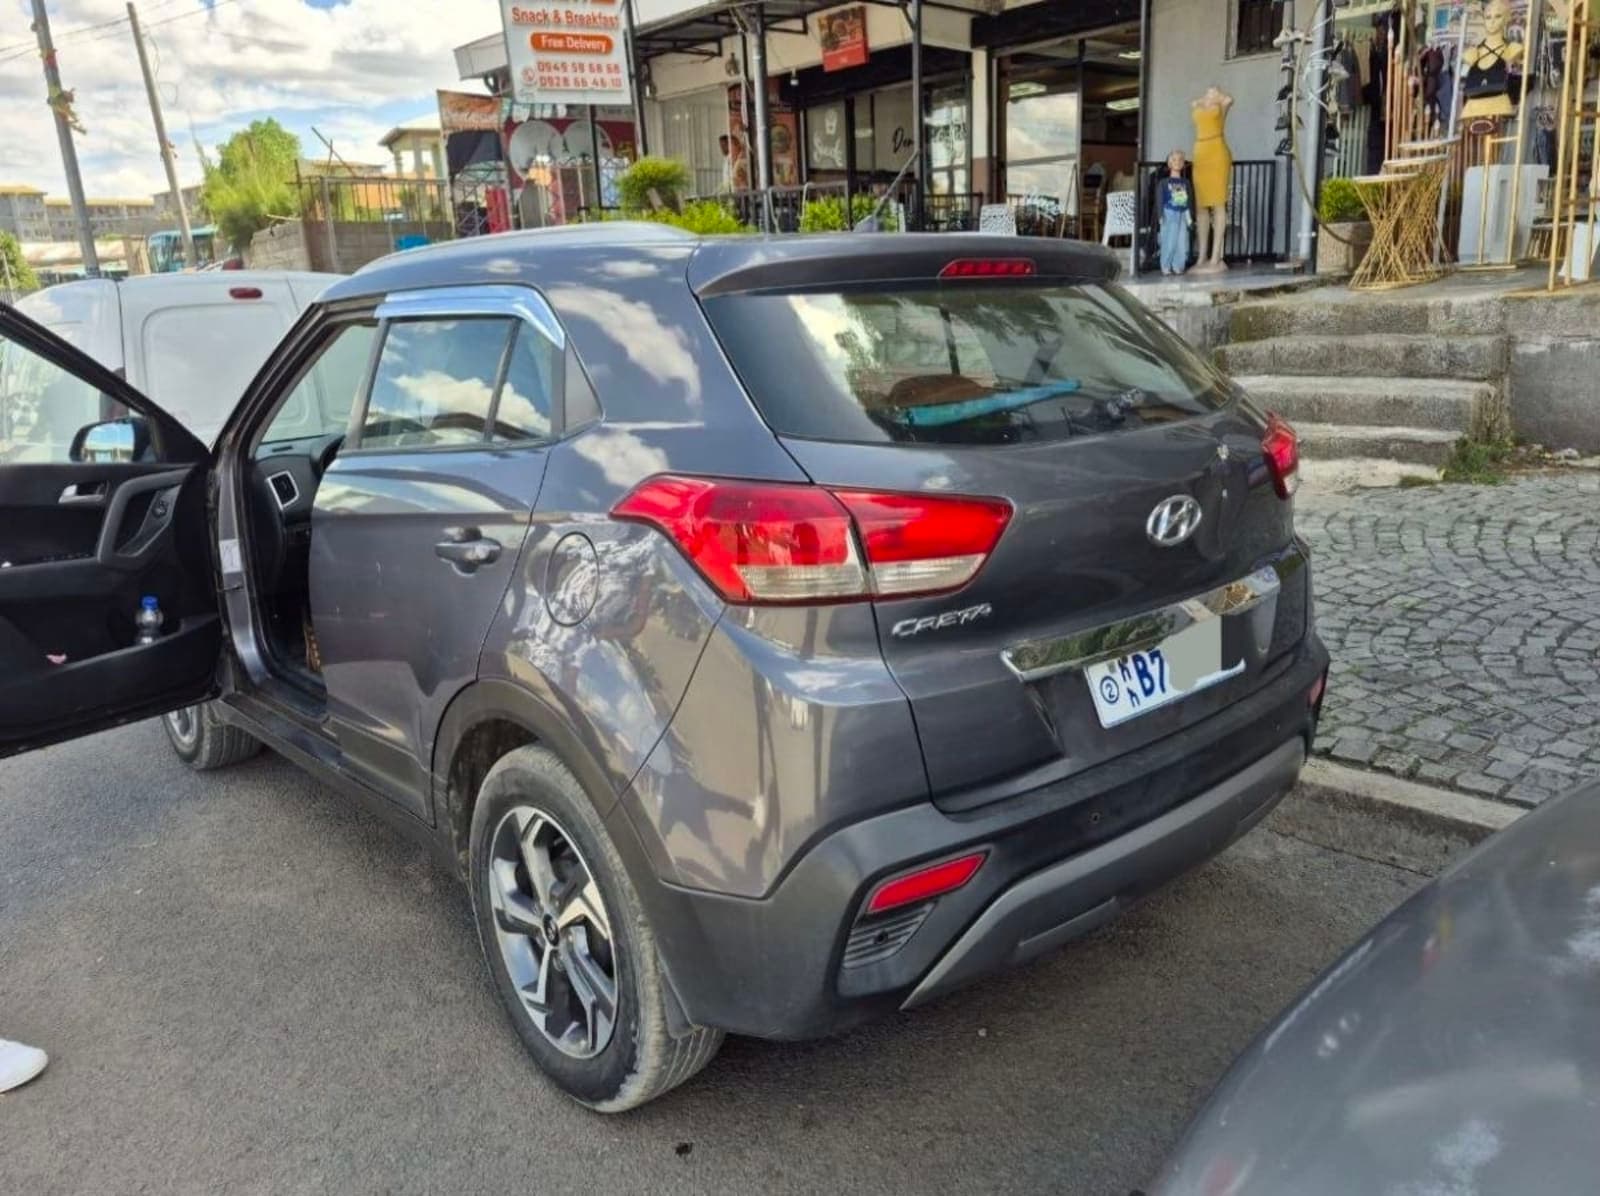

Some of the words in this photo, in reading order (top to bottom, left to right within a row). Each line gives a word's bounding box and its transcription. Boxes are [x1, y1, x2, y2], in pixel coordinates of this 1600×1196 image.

[511, 6, 549, 25] Snack
[553, 10, 561, 24] &
[565, 10, 620, 28] Breakfast
[540, 34, 564, 48] Free
[566, 36, 607, 53] Delivery
[892, 602, 993, 637] CRETA
